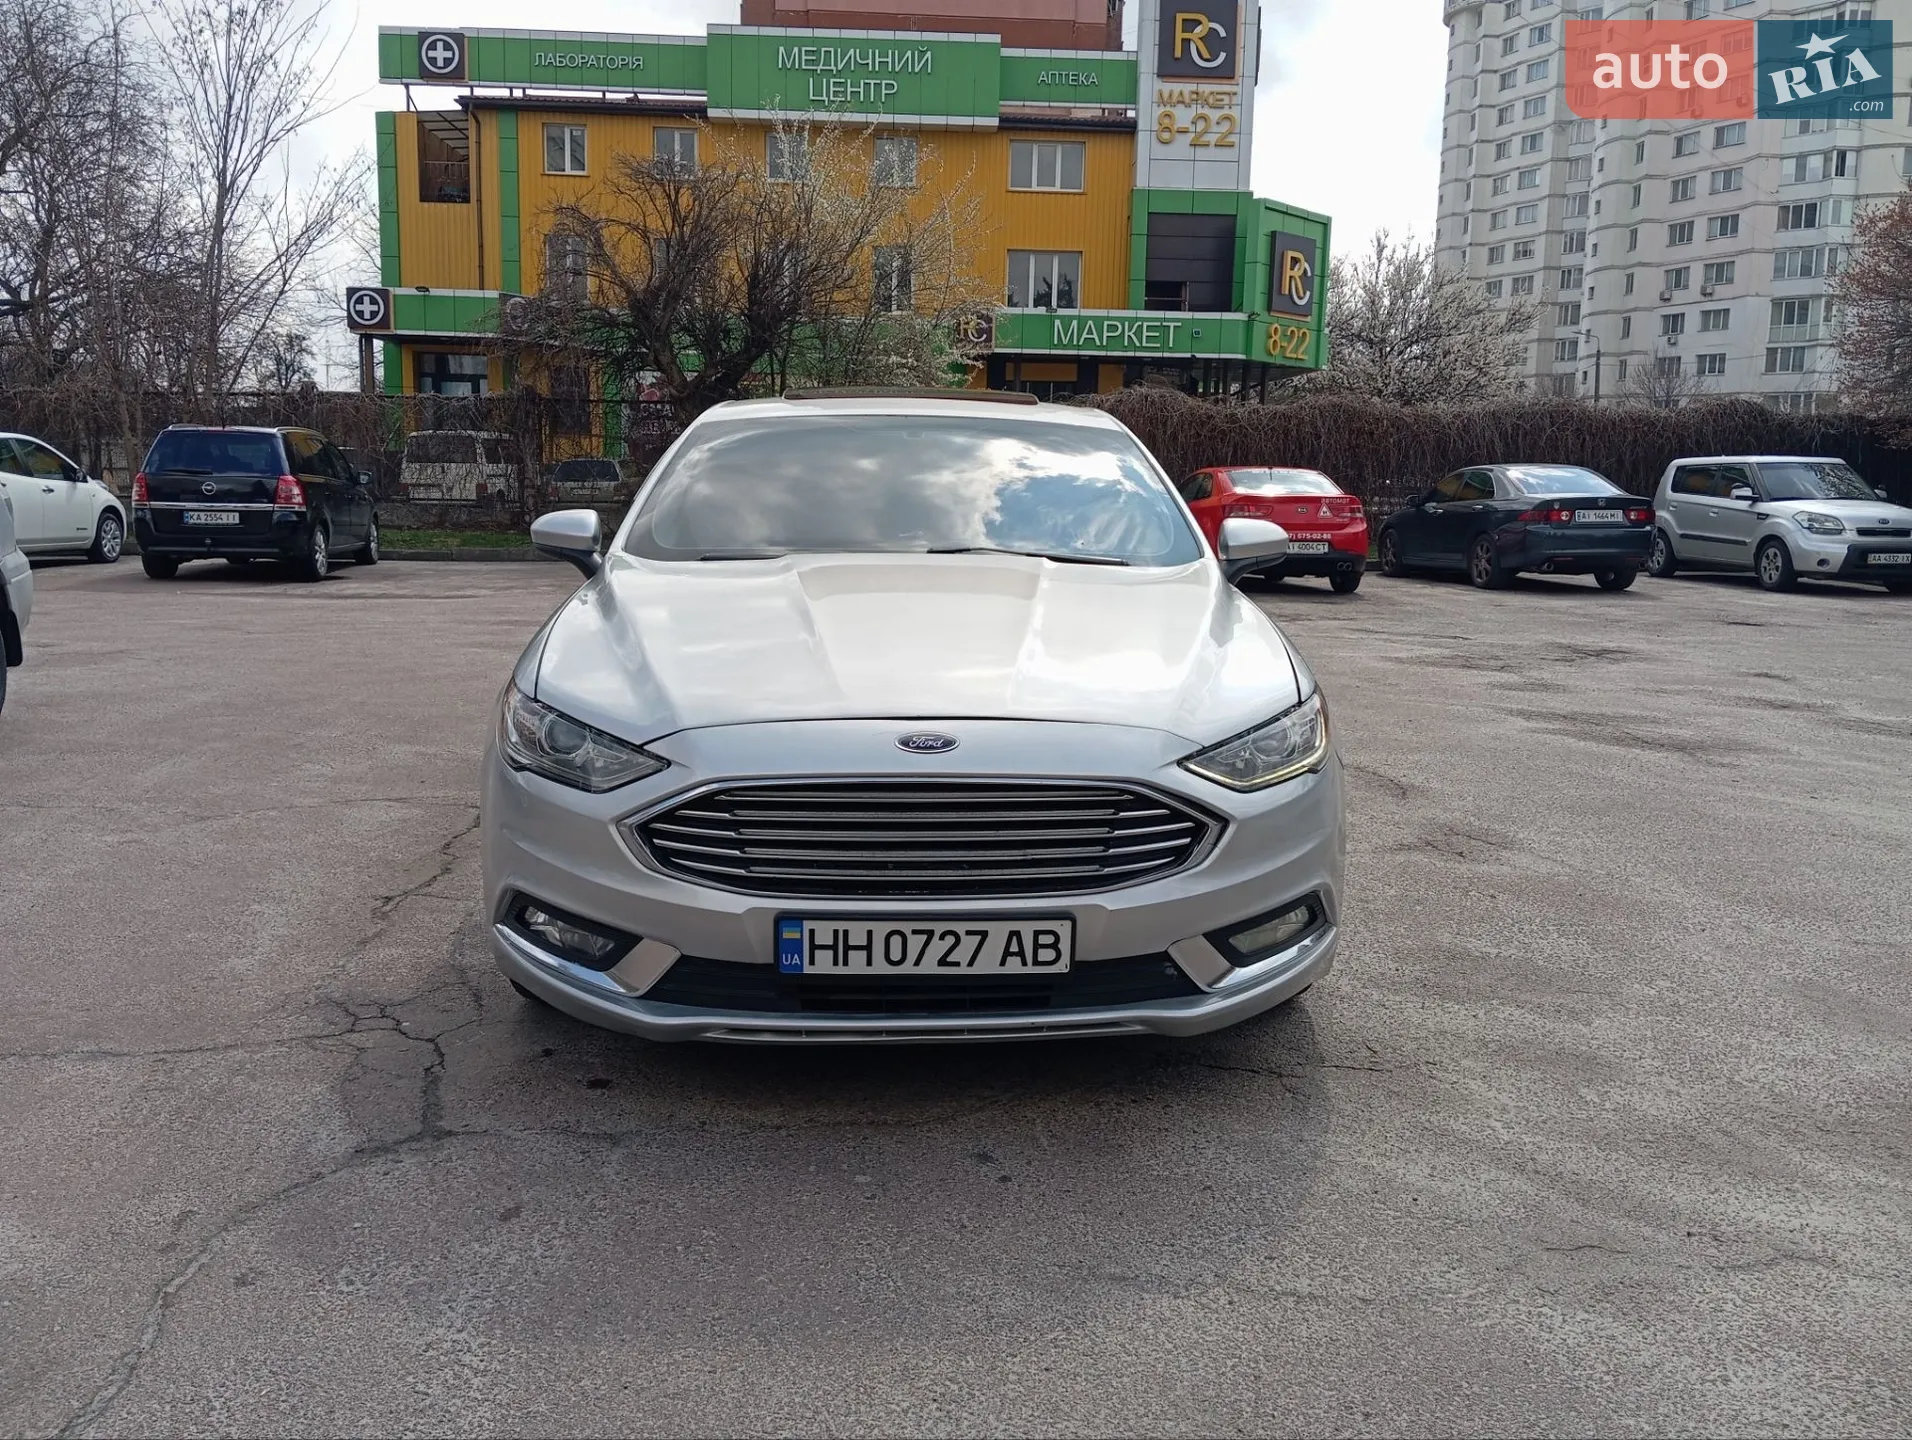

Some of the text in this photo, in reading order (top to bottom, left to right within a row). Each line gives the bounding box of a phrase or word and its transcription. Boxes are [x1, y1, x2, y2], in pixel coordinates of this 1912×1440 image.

[534, 52, 644, 70] ЛАБОРАТОРІЯ
[778, 46, 932, 74] МЕДИЧНИЙ
[1038, 71, 1098, 86] АПТЕКА
[809, 77, 898, 106] ЦЕНТР
[1157, 89, 1238, 109] МАРКЕТ
[1156, 110, 1237, 147] 8-22
[1053, 319, 1181, 348] МАРКЕТ
[1267, 323, 1310, 361] 8-22
[189, 513, 202, 521] KA
[909, 735, 944, 748] Ford
[782, 953, 800, 966] UA
[808, 928, 1062, 968] HH 0727 AB
